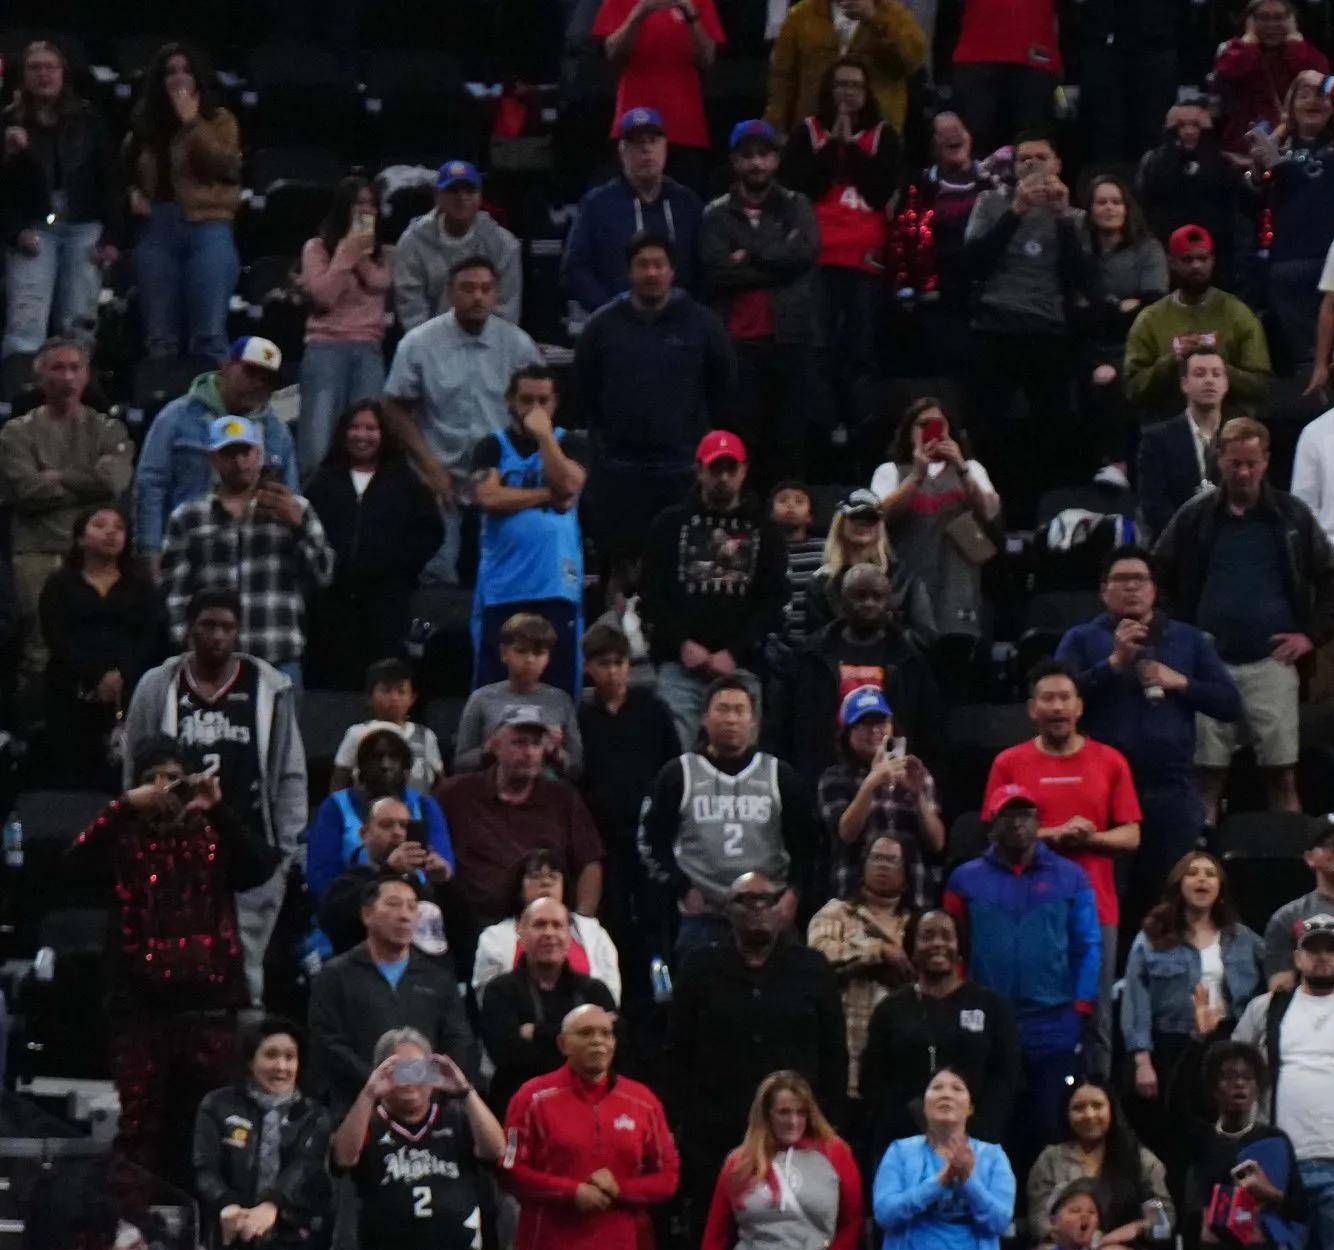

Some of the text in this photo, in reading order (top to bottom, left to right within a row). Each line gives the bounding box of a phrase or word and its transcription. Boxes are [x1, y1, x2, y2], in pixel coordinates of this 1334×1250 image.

[692, 794, 770, 823] CLIPPERS
[723, 823, 744, 857] 2
[412, 1184, 433, 1219] 2
